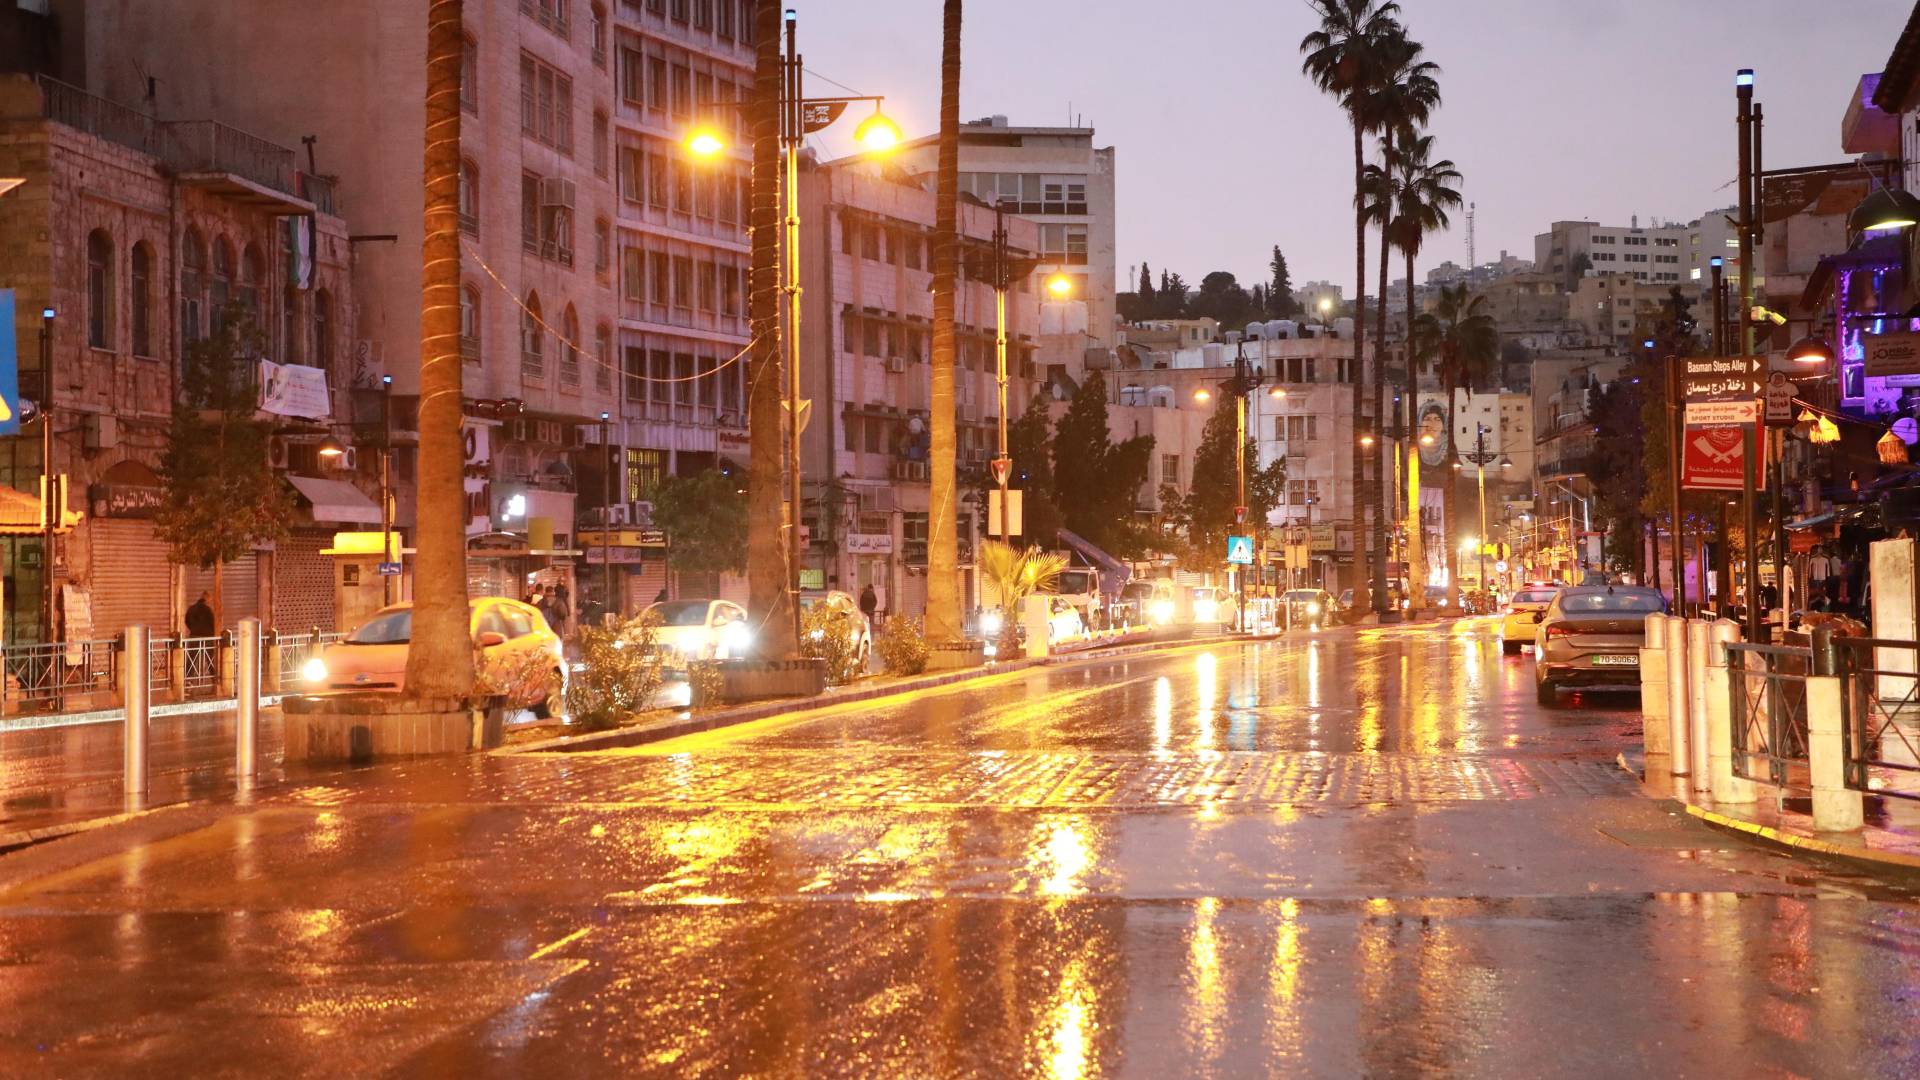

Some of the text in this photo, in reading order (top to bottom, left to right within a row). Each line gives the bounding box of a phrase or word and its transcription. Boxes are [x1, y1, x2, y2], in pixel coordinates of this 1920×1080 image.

[1687, 360, 1747, 374] Basman Steps Alley
[1686, 379, 1745, 395] دخلة درج بسمان
